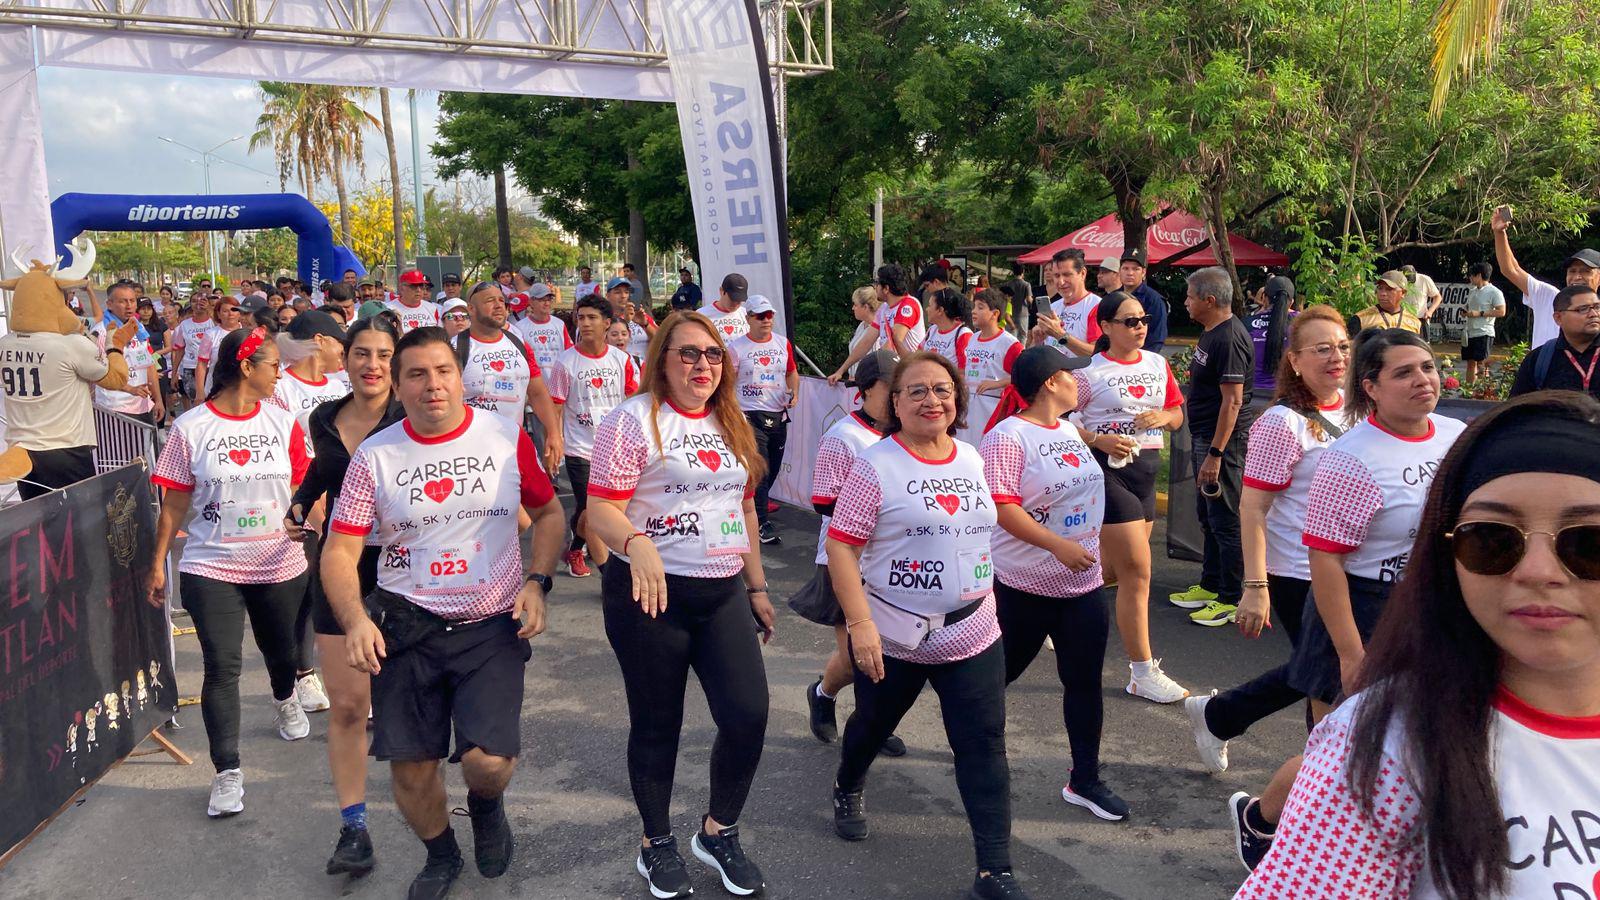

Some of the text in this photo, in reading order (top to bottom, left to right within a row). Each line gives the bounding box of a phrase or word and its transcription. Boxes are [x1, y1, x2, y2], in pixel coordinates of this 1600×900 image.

[2, 366, 43, 397] 911
[577, 367, 619, 380] CARRERA
[760, 373, 775, 381] 044
[494, 380, 515, 391] 055
[742, 389, 764, 397] DONA
[205, 434, 281, 452] CARRERA
[229, 473, 242, 483] 5K
[245, 474, 252, 484] y
[395, 455, 497, 487] CARRERA
[695, 482, 710, 491] 5K
[906, 477, 987, 495] CARRERA
[237, 515, 267, 528] 061
[422, 514, 439, 526] 5K
[444, 513, 452, 525] y
[457, 506, 510, 520] Caminata
[1064, 511, 1088, 528] 061
[720, 520, 744, 536] 040
[905, 525, 934, 537] 2.5K,
[939, 524, 951, 535] 5K
[954, 527, 961, 538] y
[430, 559, 469, 577] 023
[888, 571, 944, 590] DONA
